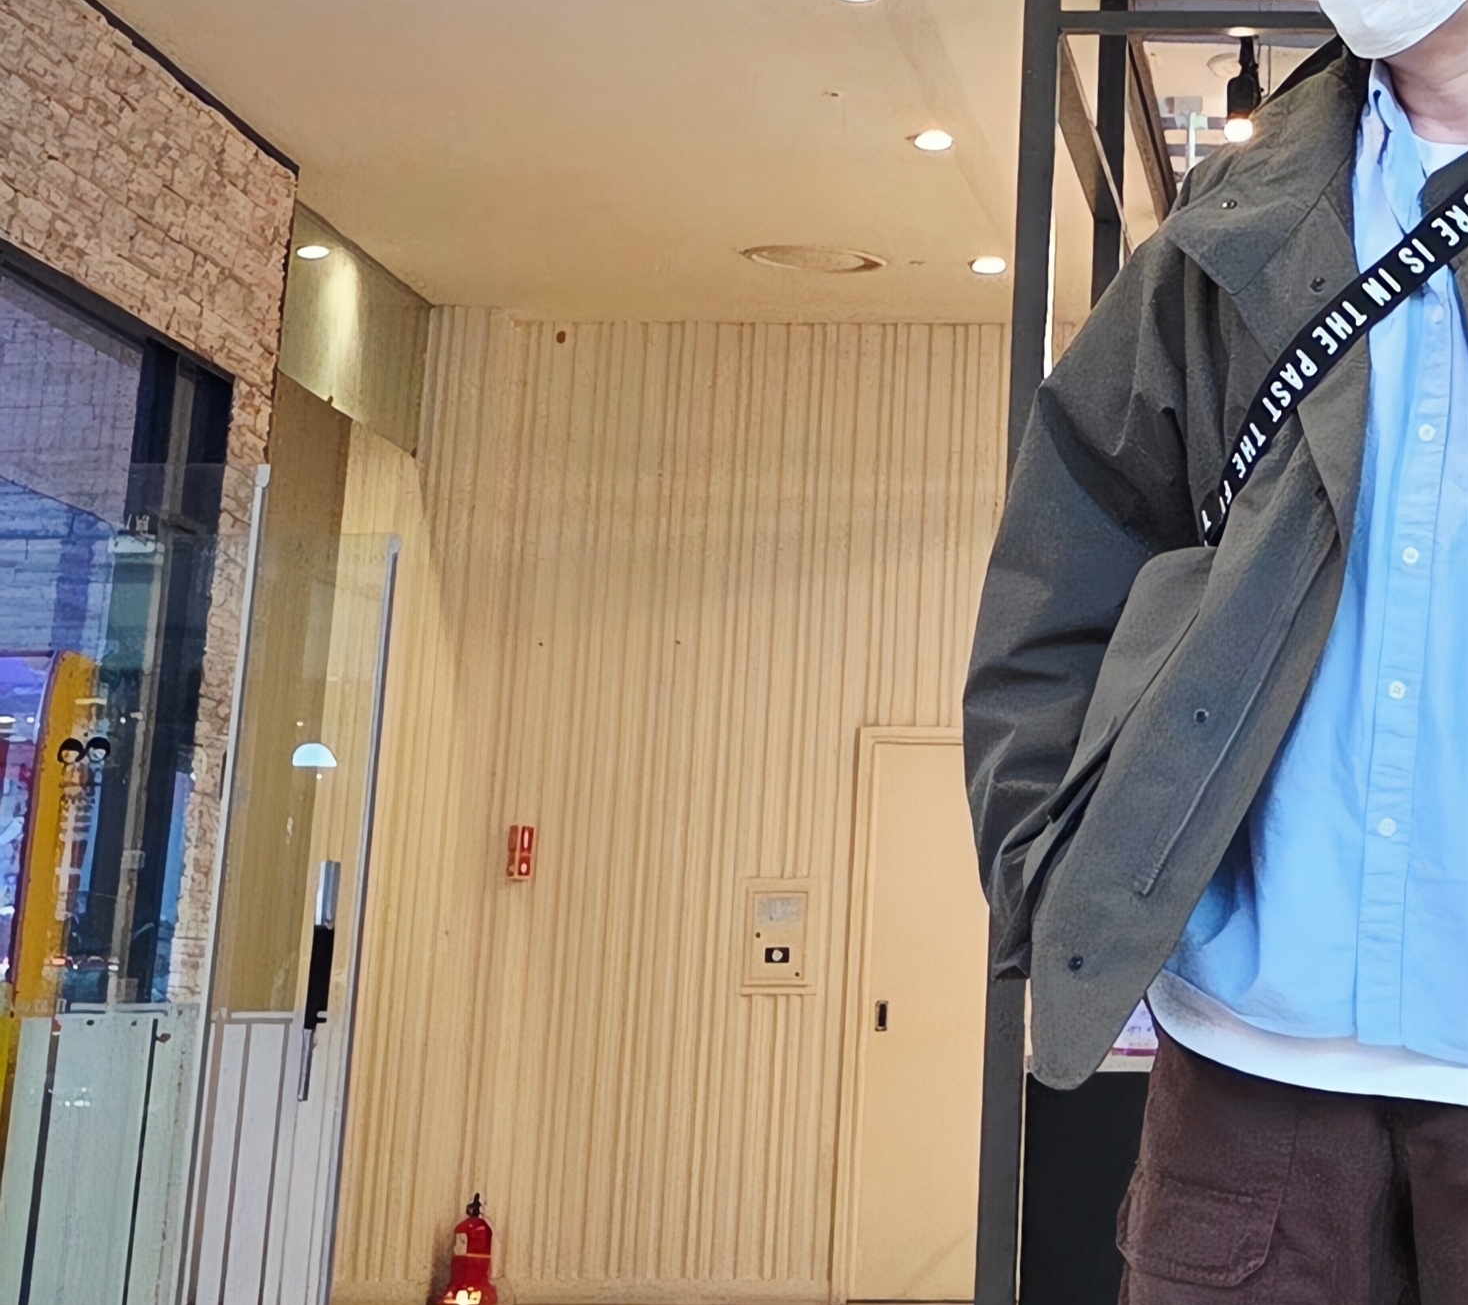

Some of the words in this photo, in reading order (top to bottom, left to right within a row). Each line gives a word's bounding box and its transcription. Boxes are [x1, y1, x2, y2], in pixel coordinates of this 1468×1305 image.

[1399, 238, 1436, 274] IS
[1362, 267, 1402, 307] IN
[1312, 300, 1368, 355] THE
[1262, 349, 1318, 423] PAST
[1232, 422, 1266, 479] THE
